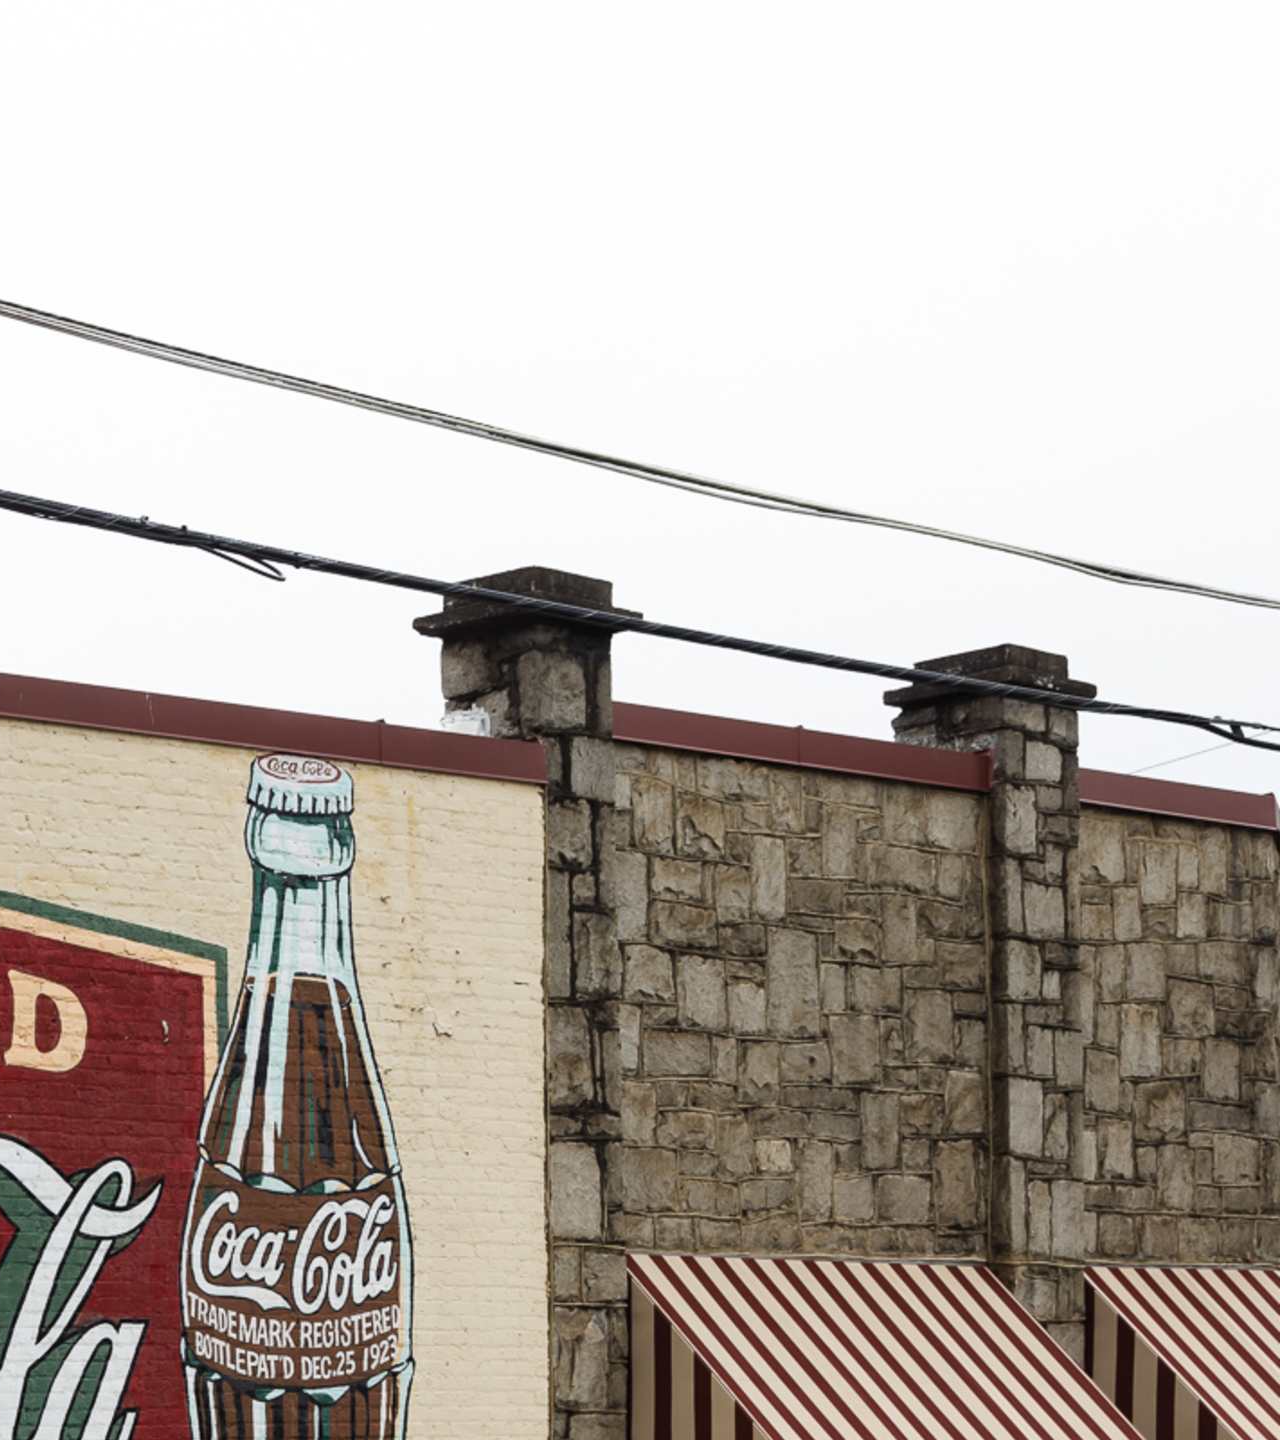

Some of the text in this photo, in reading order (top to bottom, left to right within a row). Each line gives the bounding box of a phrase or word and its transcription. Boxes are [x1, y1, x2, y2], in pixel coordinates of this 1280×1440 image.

[191, 1190, 398, 1314] Coca-Cola
[300, 1304, 400, 1348] REGISTERED
[363, 1334, 398, 1372] 1923
